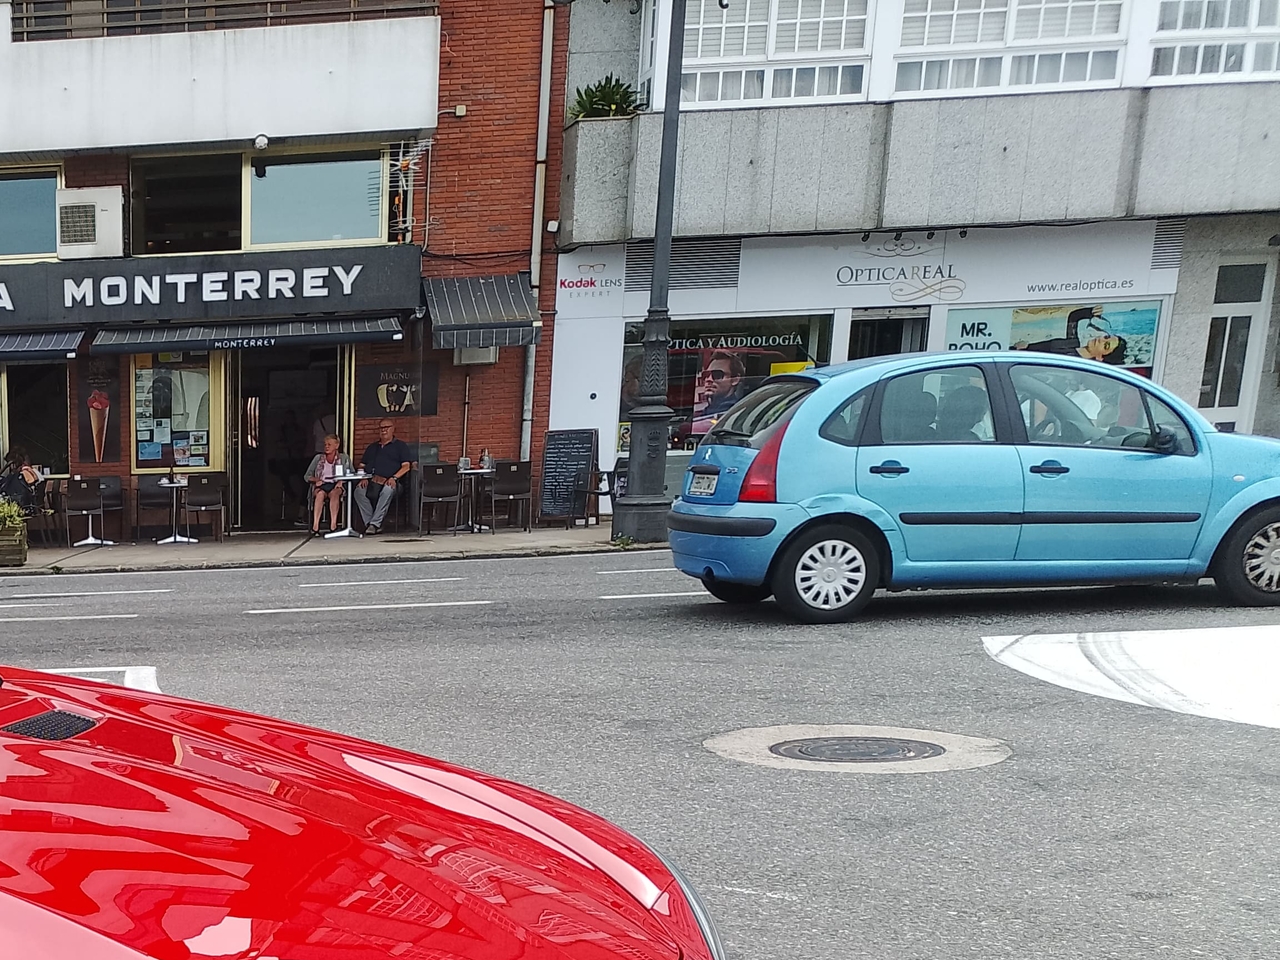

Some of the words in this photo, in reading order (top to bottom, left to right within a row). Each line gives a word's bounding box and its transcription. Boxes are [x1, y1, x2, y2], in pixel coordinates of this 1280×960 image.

[63, 264, 364, 308] MONTERREY
[560, 277, 596, 288] Kodak
[601, 278, 622, 288] LENS
[1027, 278, 1134, 293] www.realoptica.es
[569, 290, 610, 298] EXPERT
[960, 322, 992, 338] MR.
[214, 338, 276, 349] MONTERREY
[667, 337, 704, 350] PTICA
[706, 338, 717, 348] Y
[717, 331, 803, 348] AUDIOLOGÍA
[380, 371, 412, 380] MAGNU
